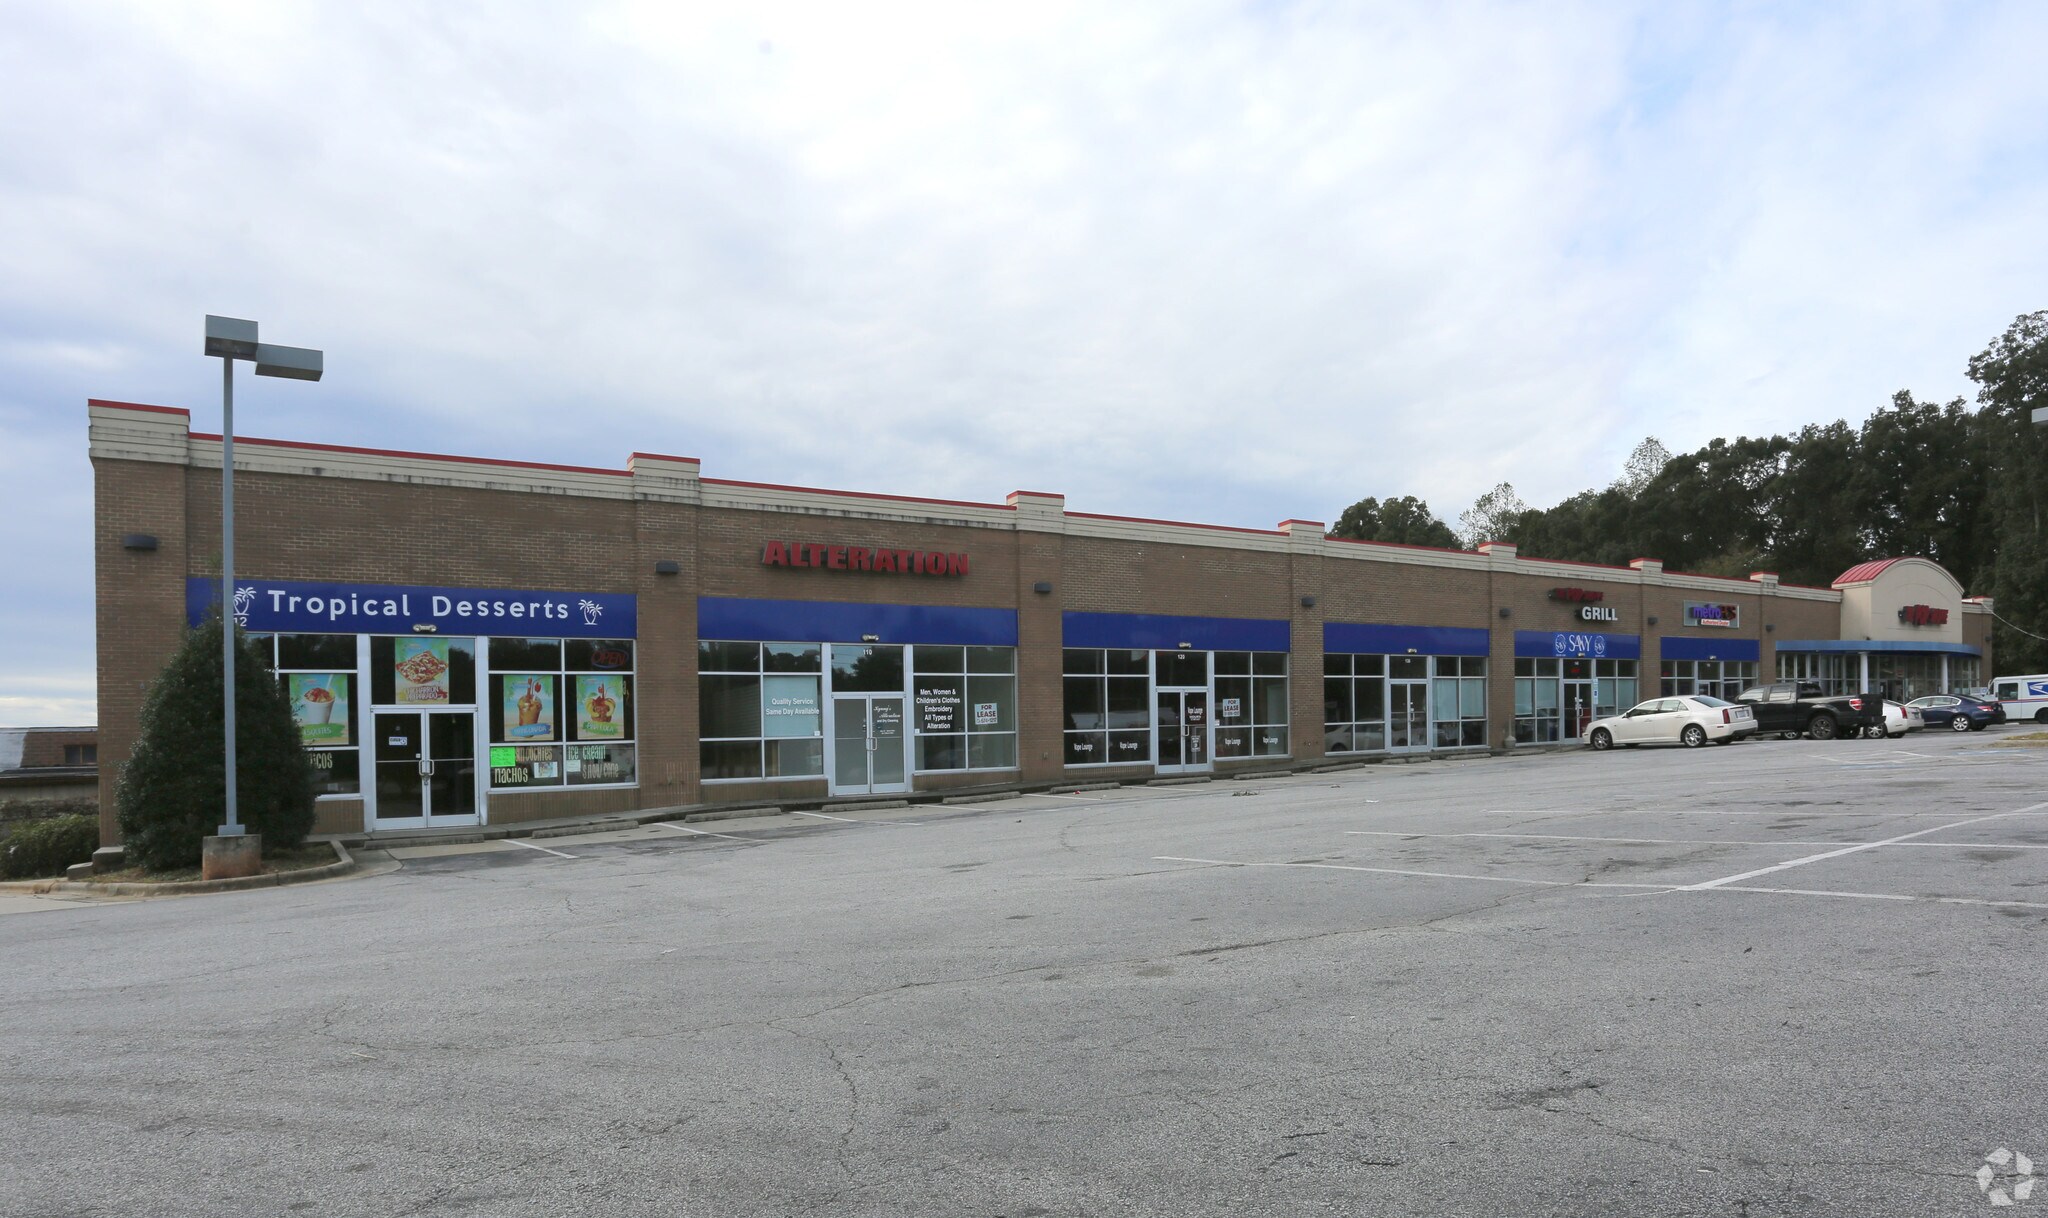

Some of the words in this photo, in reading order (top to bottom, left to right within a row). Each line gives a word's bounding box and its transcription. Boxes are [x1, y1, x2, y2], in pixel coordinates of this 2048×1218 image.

[763, 540, 970, 576] ALTERATION
[268, 590, 410, 620] Tropical
[432, 596, 568, 618] Desserts
[1581, 606, 1618, 621] GRILL
[771, 698, 791, 706] Quality
[782, 708, 793, 716] Day
